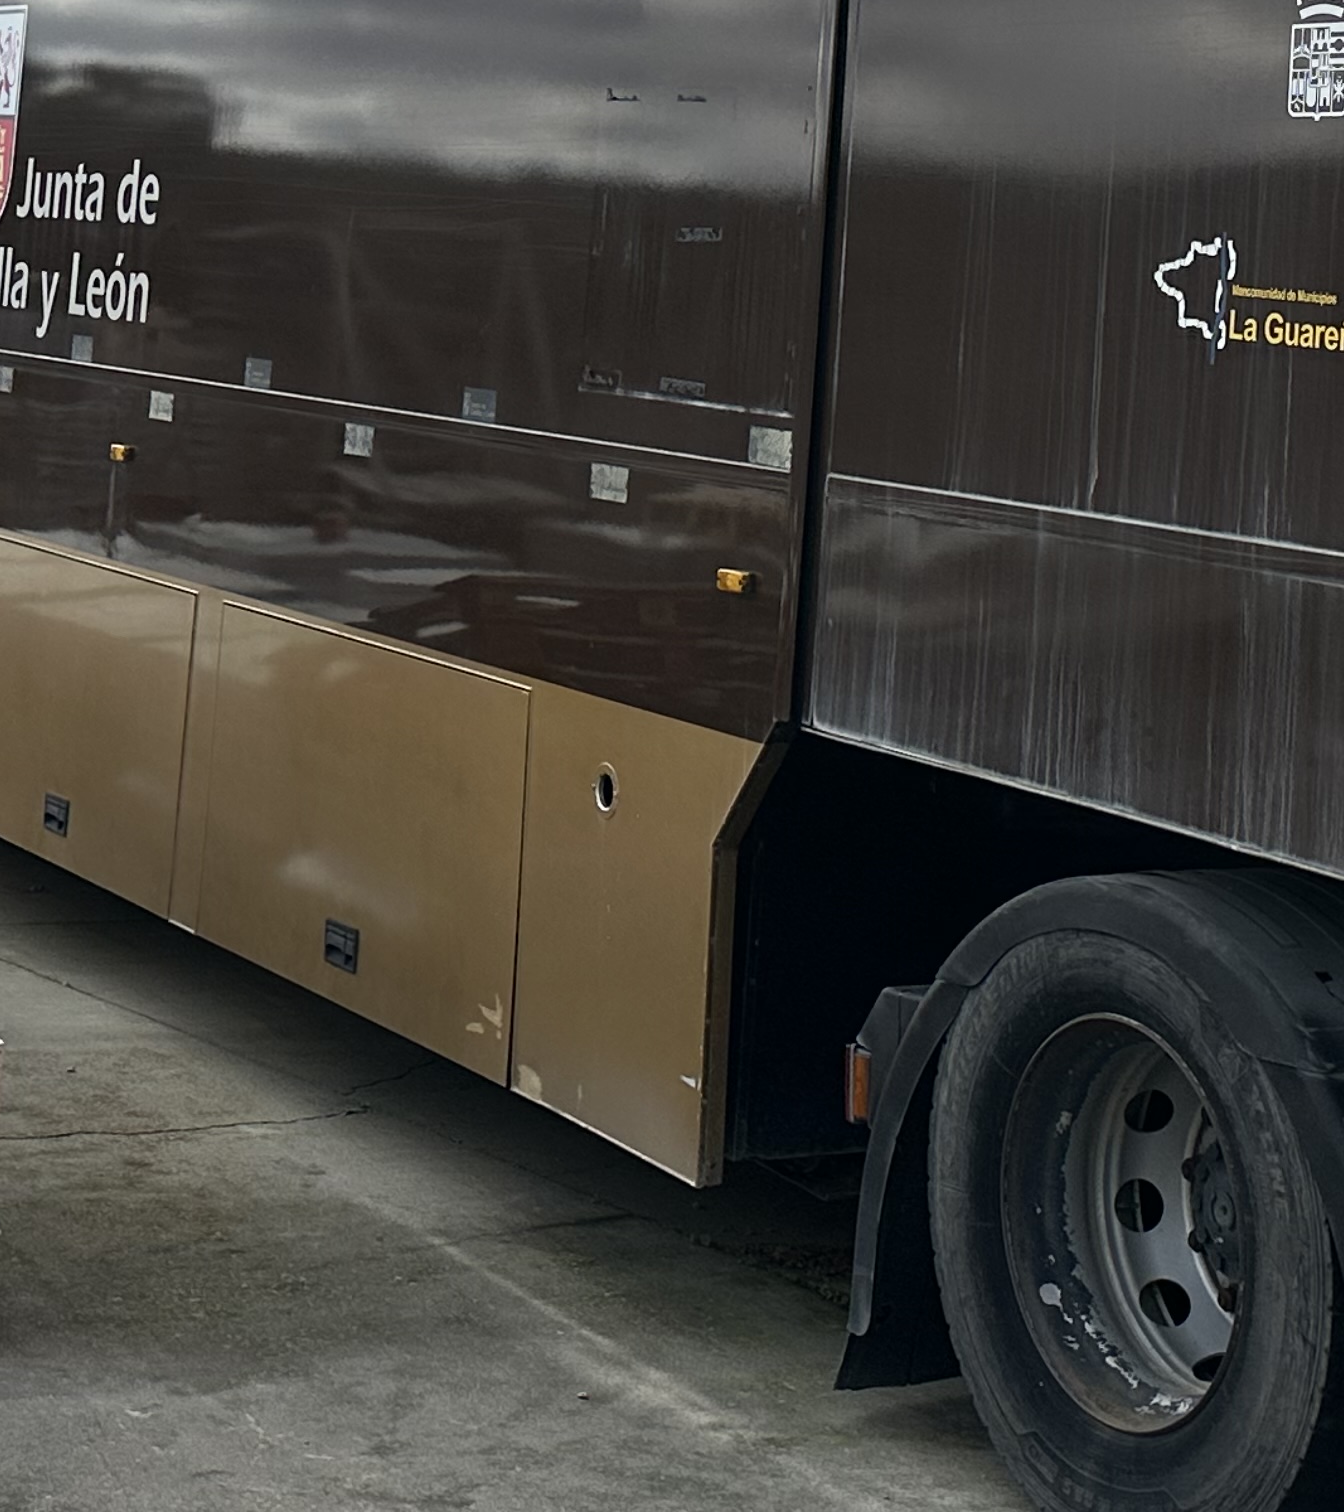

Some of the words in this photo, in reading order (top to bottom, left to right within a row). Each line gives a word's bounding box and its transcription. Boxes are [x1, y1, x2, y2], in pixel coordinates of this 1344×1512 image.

[16, 157, 105, 222] Junta
[116, 158, 160, 225] de
[35, 269, 60, 338] y
[68, 251, 150, 324] León
[1229, 309, 1258, 342] La
